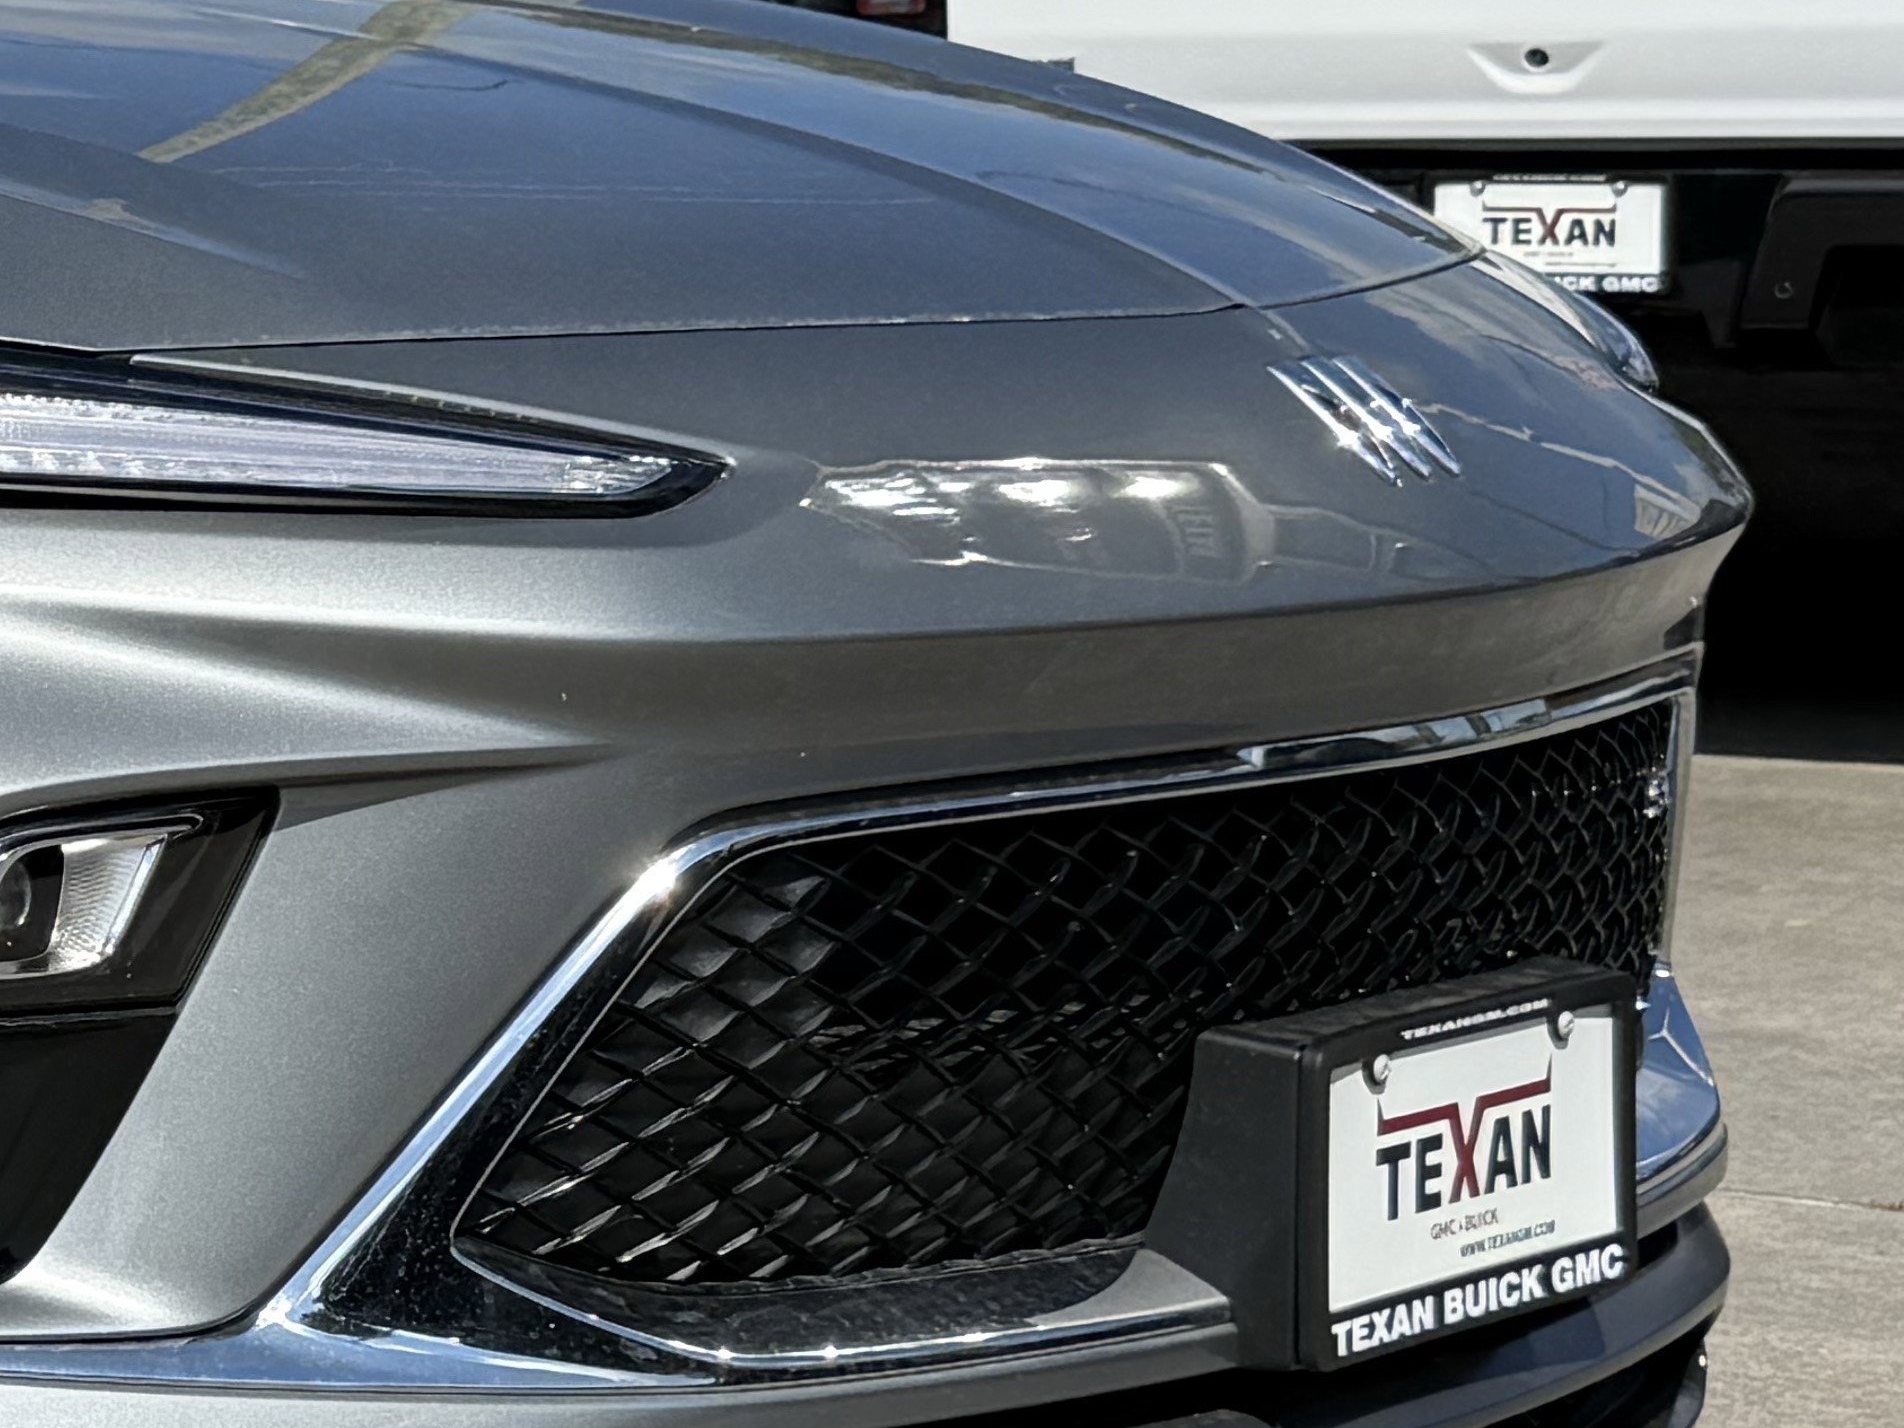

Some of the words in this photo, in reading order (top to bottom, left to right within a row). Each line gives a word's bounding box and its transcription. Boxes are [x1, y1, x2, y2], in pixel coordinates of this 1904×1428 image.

[1482, 206, 1617, 247] TEXAN
[1602, 276, 1660, 293] GMC
[1376, 1076, 1553, 1221] TEXAN
[1331, 1295, 1435, 1357] TEXAN
[1444, 1264, 1548, 1324] BUICK
[1551, 1243, 1624, 1293] GMC
